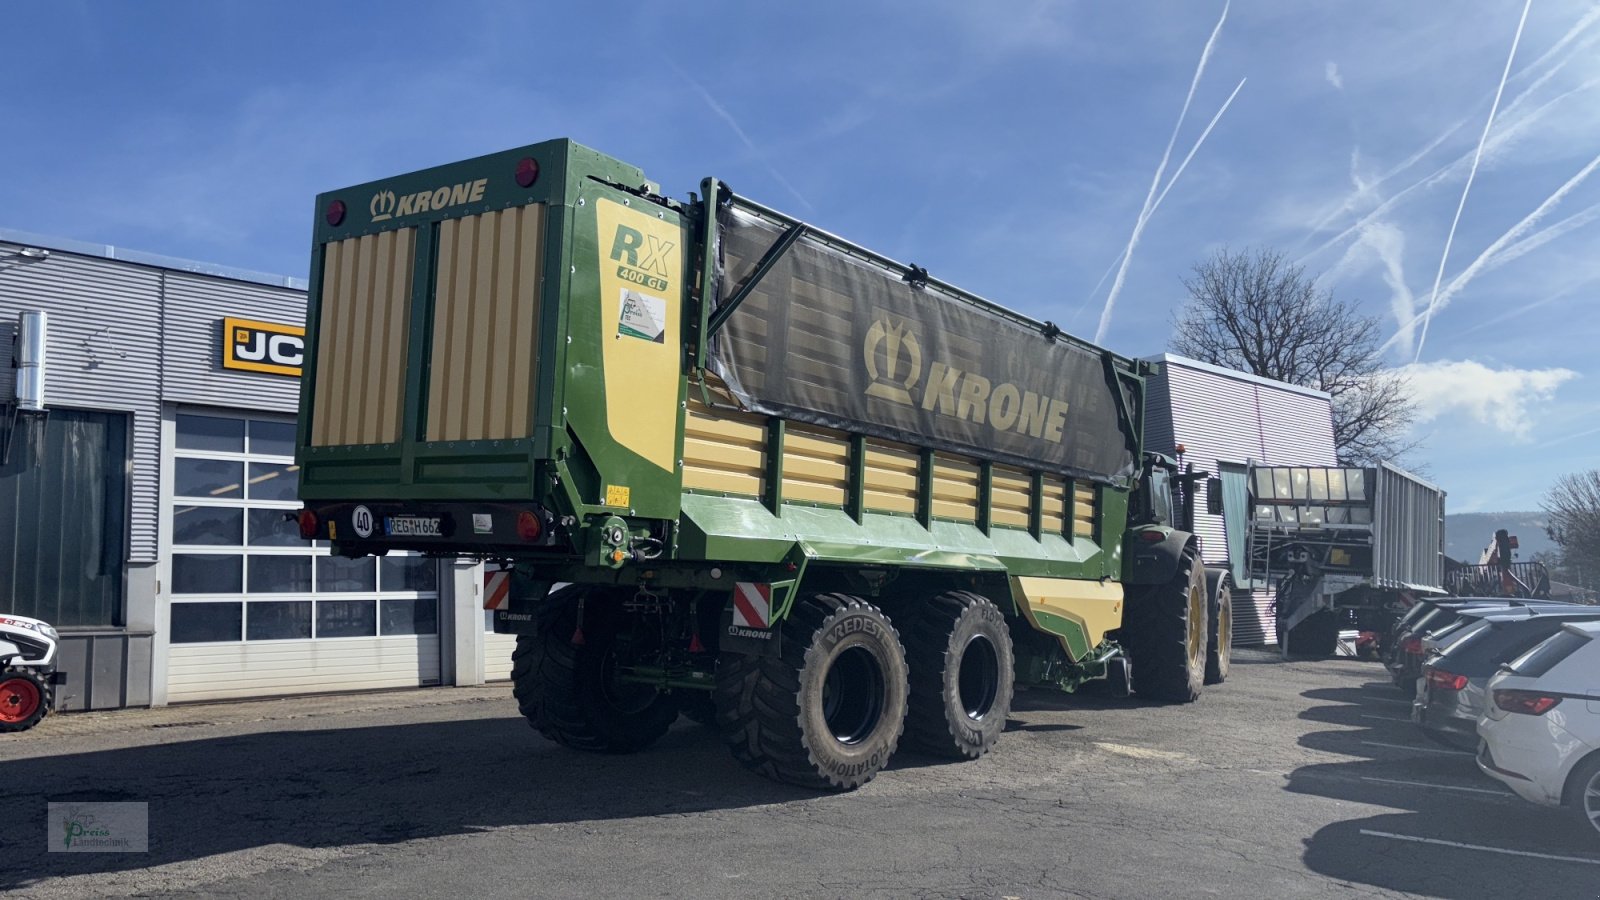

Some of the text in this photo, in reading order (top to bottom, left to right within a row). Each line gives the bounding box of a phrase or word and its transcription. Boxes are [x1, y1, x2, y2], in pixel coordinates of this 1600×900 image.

[395, 178, 488, 218] KRONE
[610, 223, 675, 278] RX
[620, 268, 664, 291] 400 GL
[236, 332, 304, 366] JC
[921, 361, 1069, 444] KRONE
[357, 511, 369, 532] 40
[390, 519, 409, 533] REG
[738, 629, 773, 640] KRONE
[827, 738, 889, 777] FLOTATION
